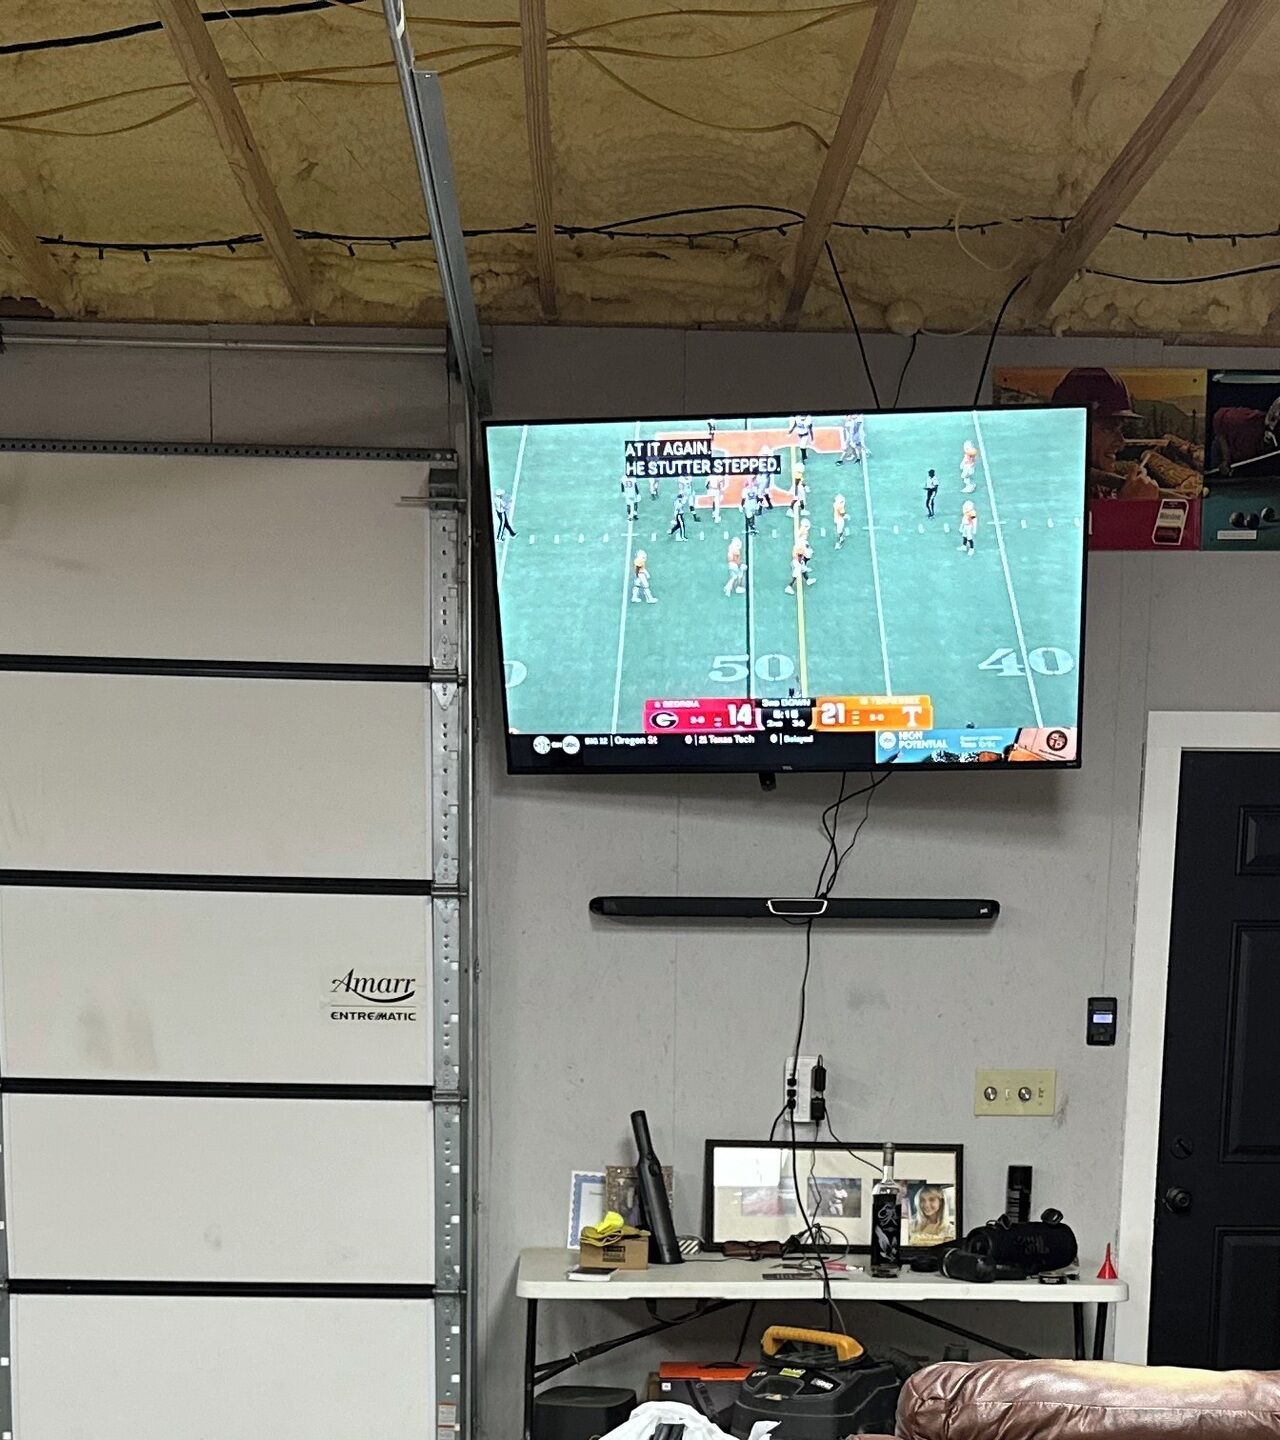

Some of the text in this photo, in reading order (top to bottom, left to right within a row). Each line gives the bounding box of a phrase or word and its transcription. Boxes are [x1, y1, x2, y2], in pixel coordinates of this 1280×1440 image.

[625, 441, 712, 457] AT IT AGAIN.
[626, 457, 781, 476] HE STUTTER STEPPED.
[708, 653, 795, 683] 50
[978, 646, 1075, 677] 40
[728, 703, 752, 726] 14
[821, 702, 845, 725] 21
[614, 735, 658, 747] Oregon St
[734, 734, 755, 744] Tech
[898, 739, 949, 750] POTENTIAL
[330, 968, 416, 1003] Amarr
[330, 1011, 416, 1021] ENTREMATIC
